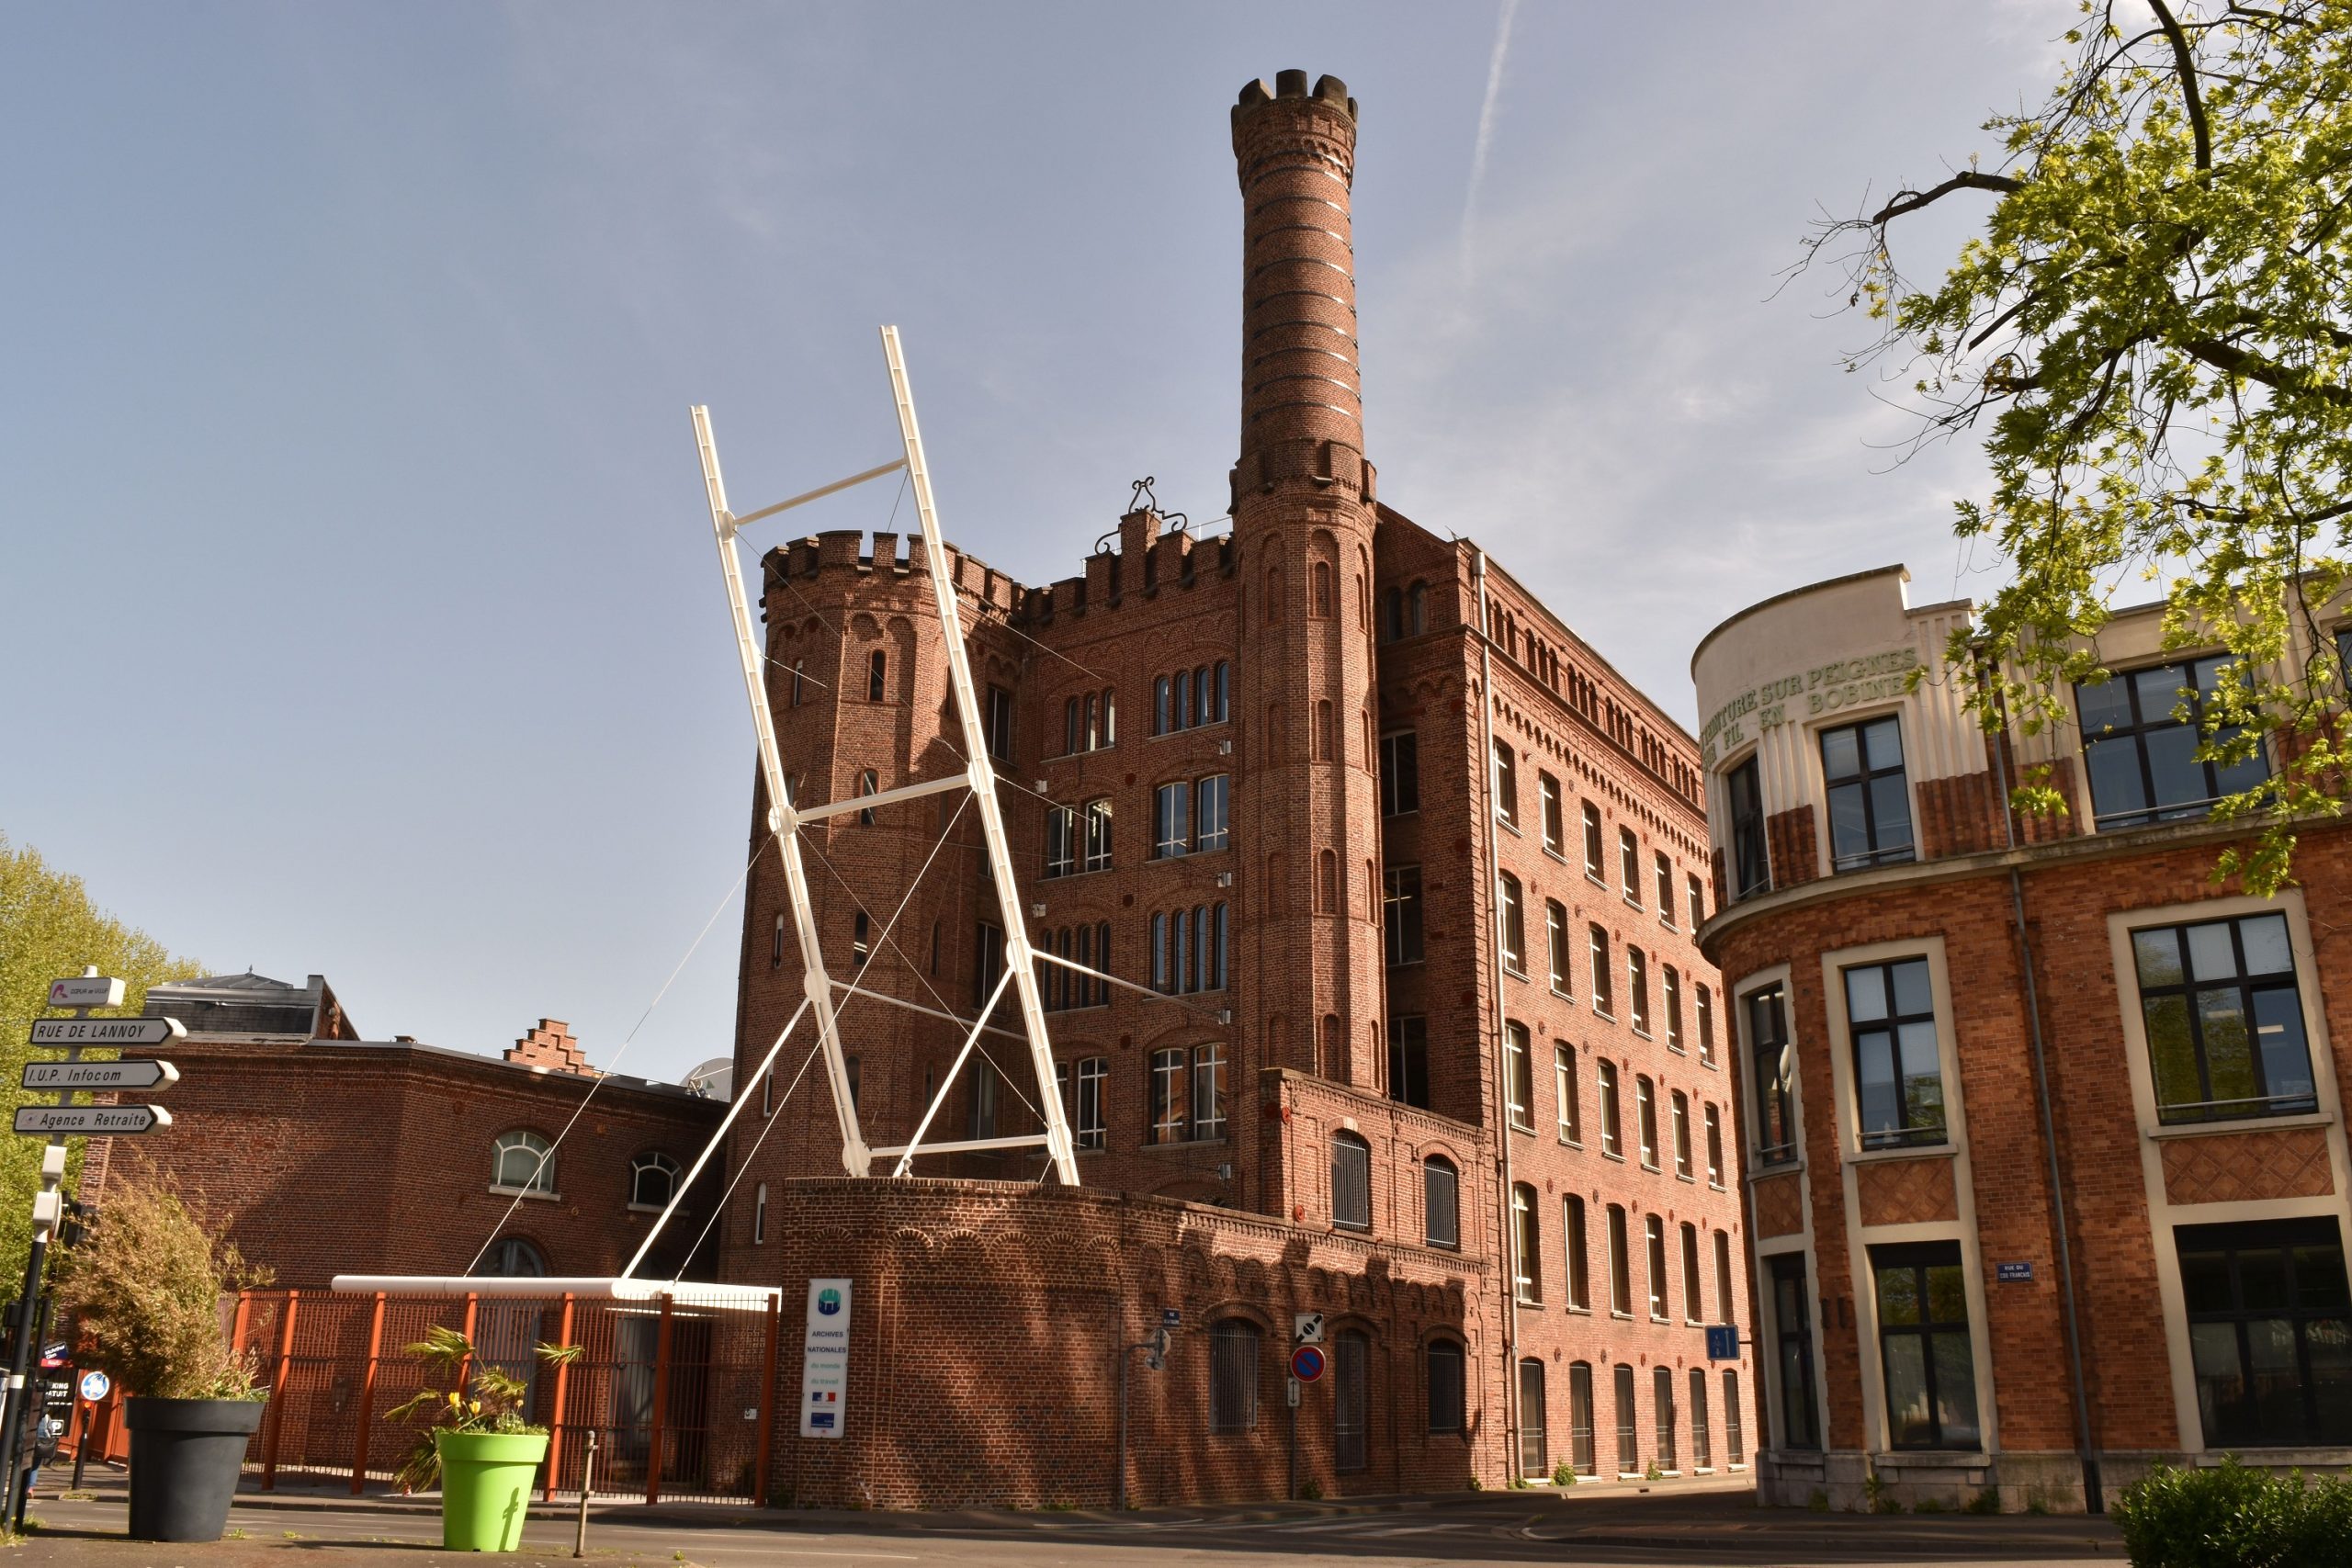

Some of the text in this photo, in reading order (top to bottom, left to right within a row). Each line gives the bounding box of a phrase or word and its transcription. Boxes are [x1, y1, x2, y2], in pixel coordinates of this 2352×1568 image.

[1761, 673, 1804, 705] SUR
[1807, 647, 1918, 691] PEIGNES
[1723, 722, 1744, 750] FIL
[1758, 704, 1785, 730] EN
[1807, 674, 1920, 715] BOBINE
[37, 1024, 145, 1038] RUE DE LANNOY
[28, 1068, 121, 1082] I.U.P. Infocom
[40, 1112, 146, 1129] Agence Retraite
